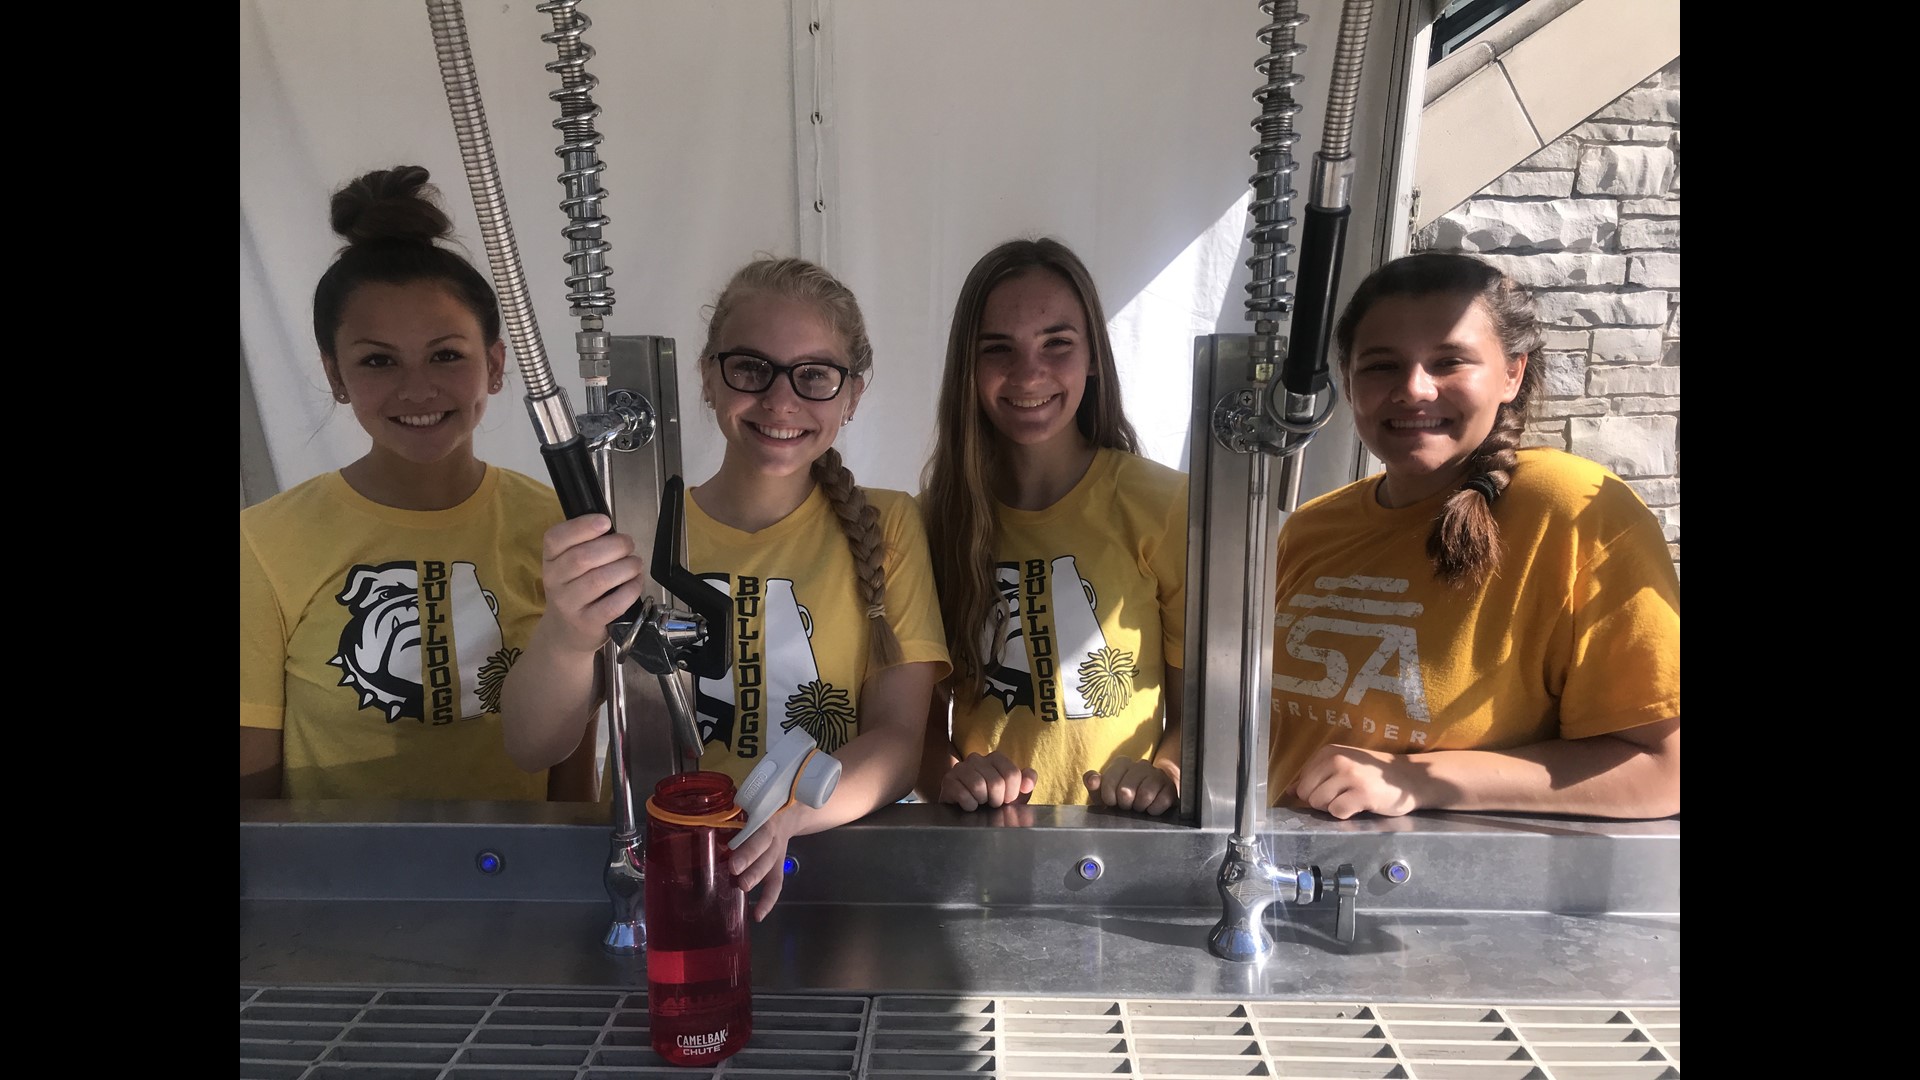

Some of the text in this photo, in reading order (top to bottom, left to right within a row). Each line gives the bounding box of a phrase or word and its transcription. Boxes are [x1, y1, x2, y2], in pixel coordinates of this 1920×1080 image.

[422, 561, 453, 726] BULLDOGS
[735, 575, 761, 759] BULLDOGS
[1024, 559, 1058, 722] BULLDOGS
[1272, 614, 1431, 722] SA
[1271, 698, 1428, 745] ERLEADER
[676, 1029, 727, 1047] CAMELBAK
